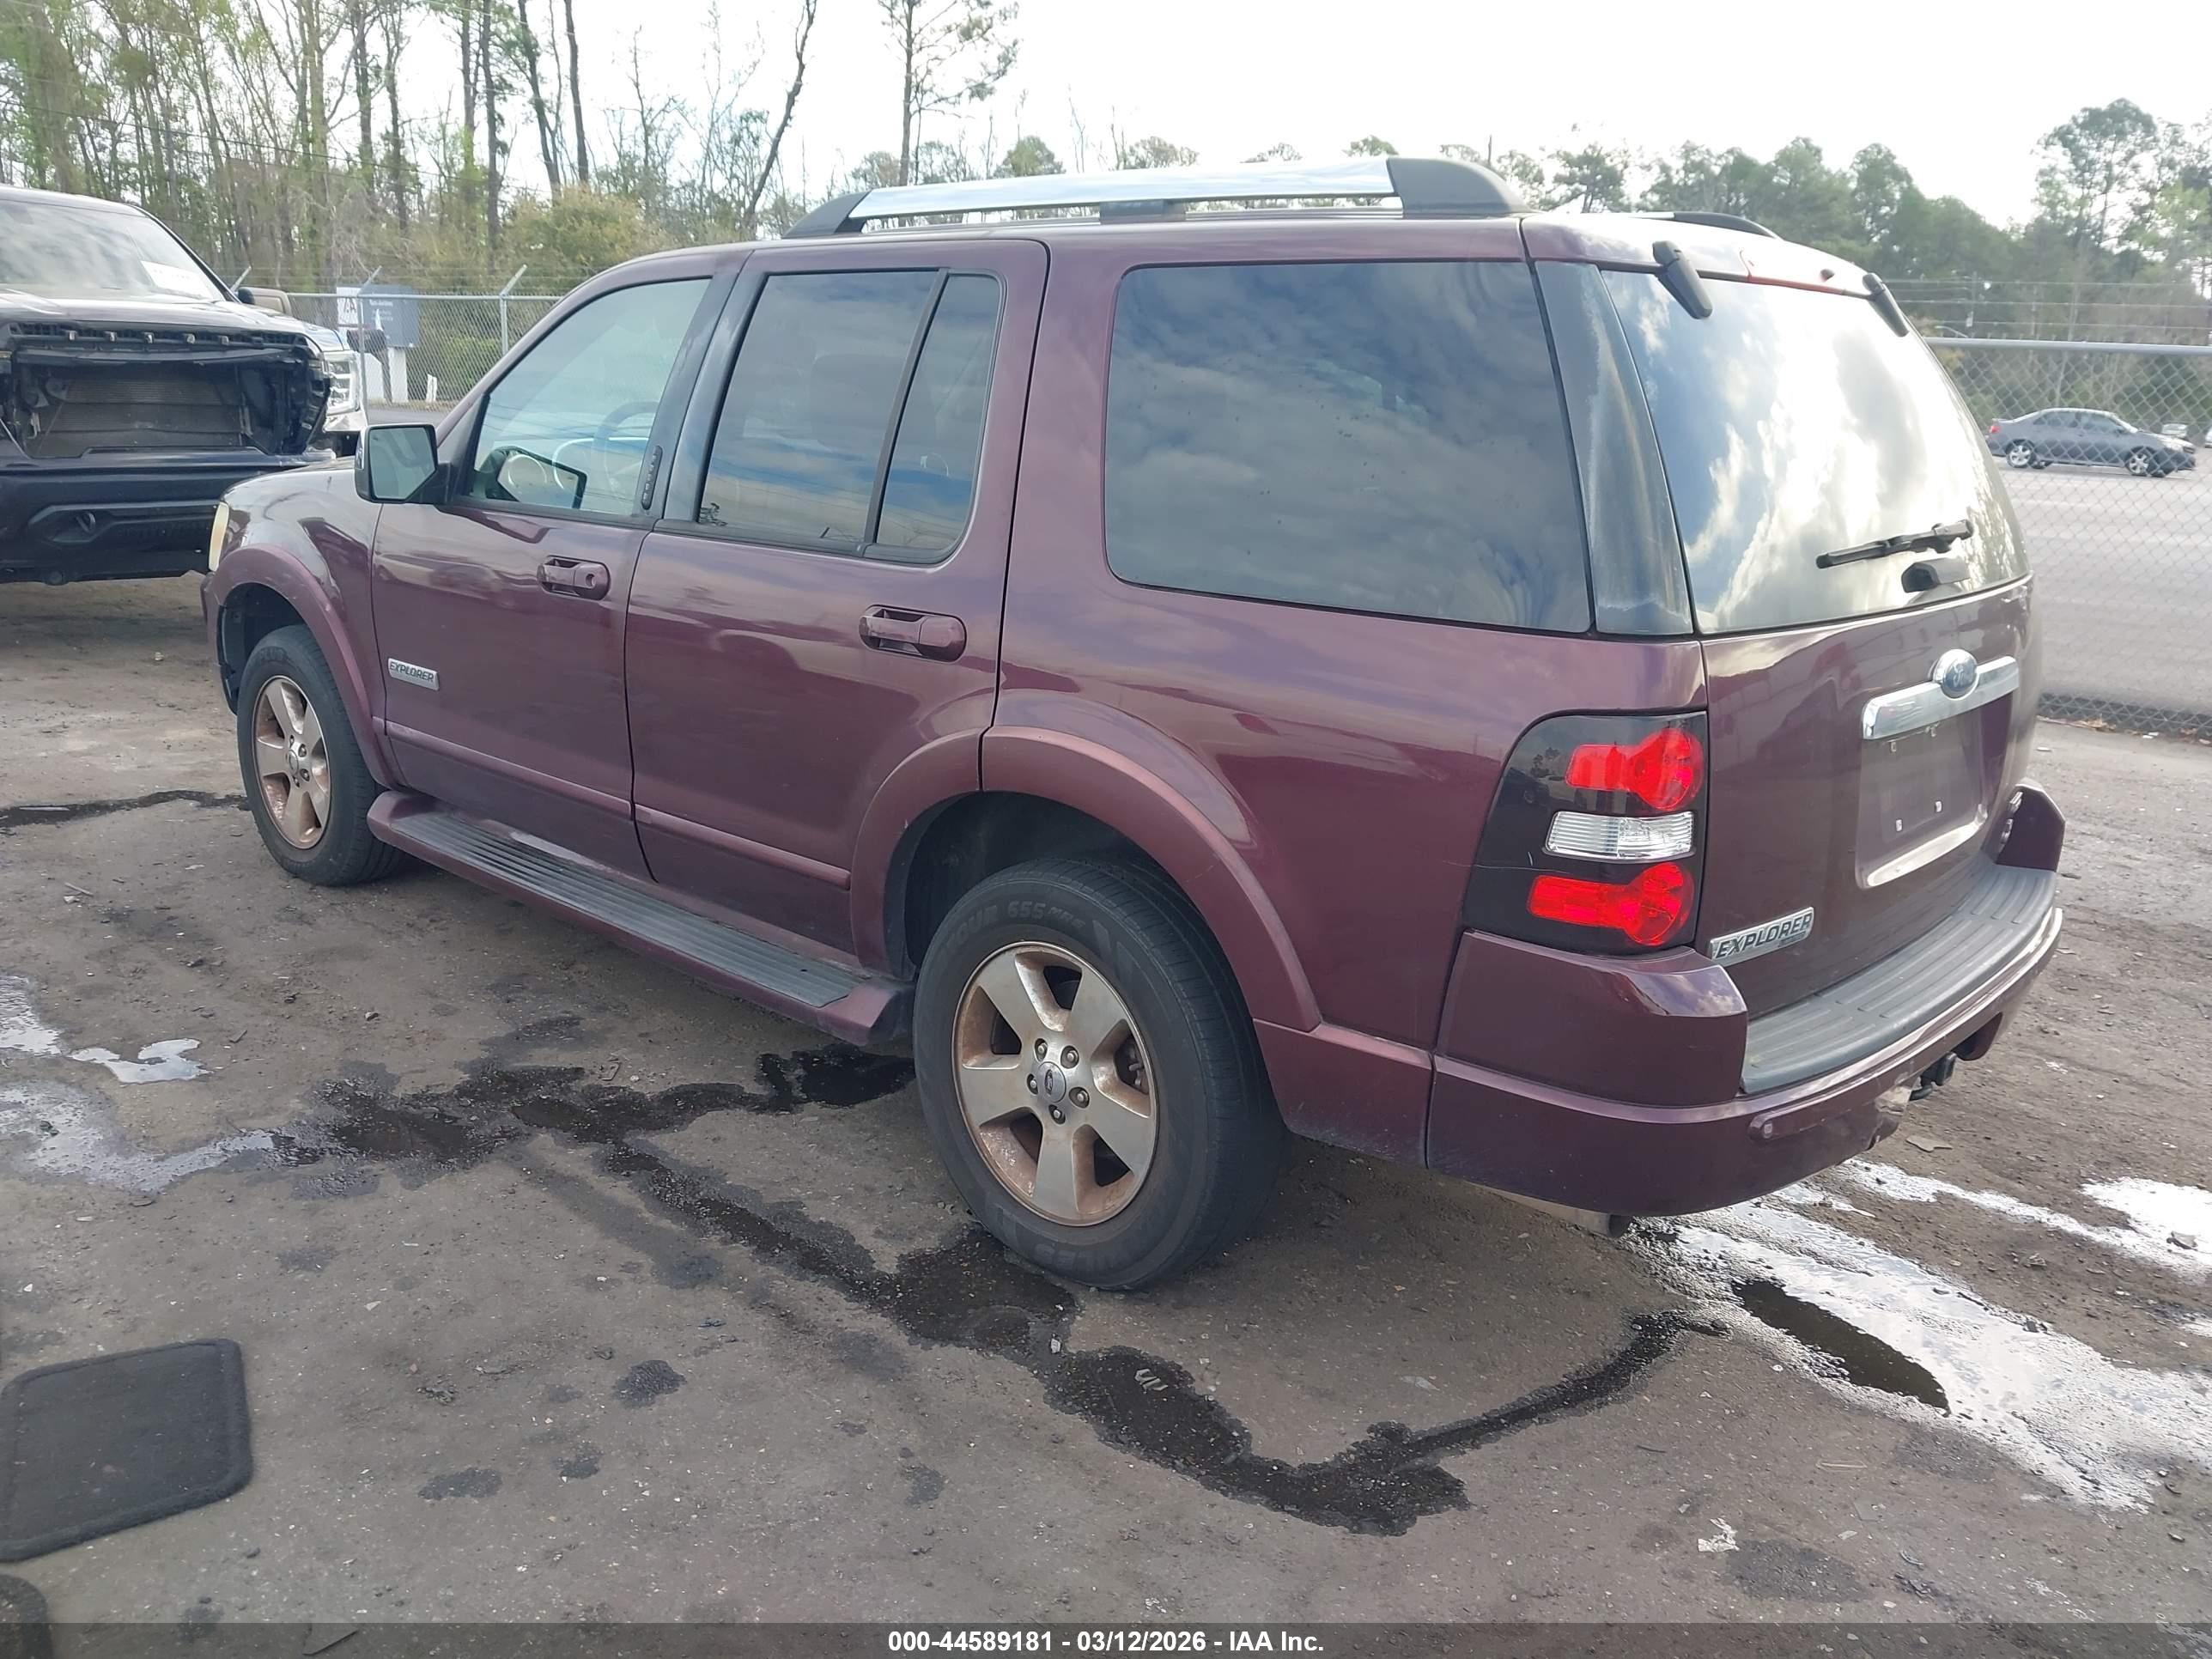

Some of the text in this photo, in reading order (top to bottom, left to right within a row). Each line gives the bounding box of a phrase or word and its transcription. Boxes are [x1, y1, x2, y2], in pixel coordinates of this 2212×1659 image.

[389, 661, 434, 683] EXPLORER
[1006, 901, 1046, 921] 655
[1715, 913, 1814, 959] EXPLORER
